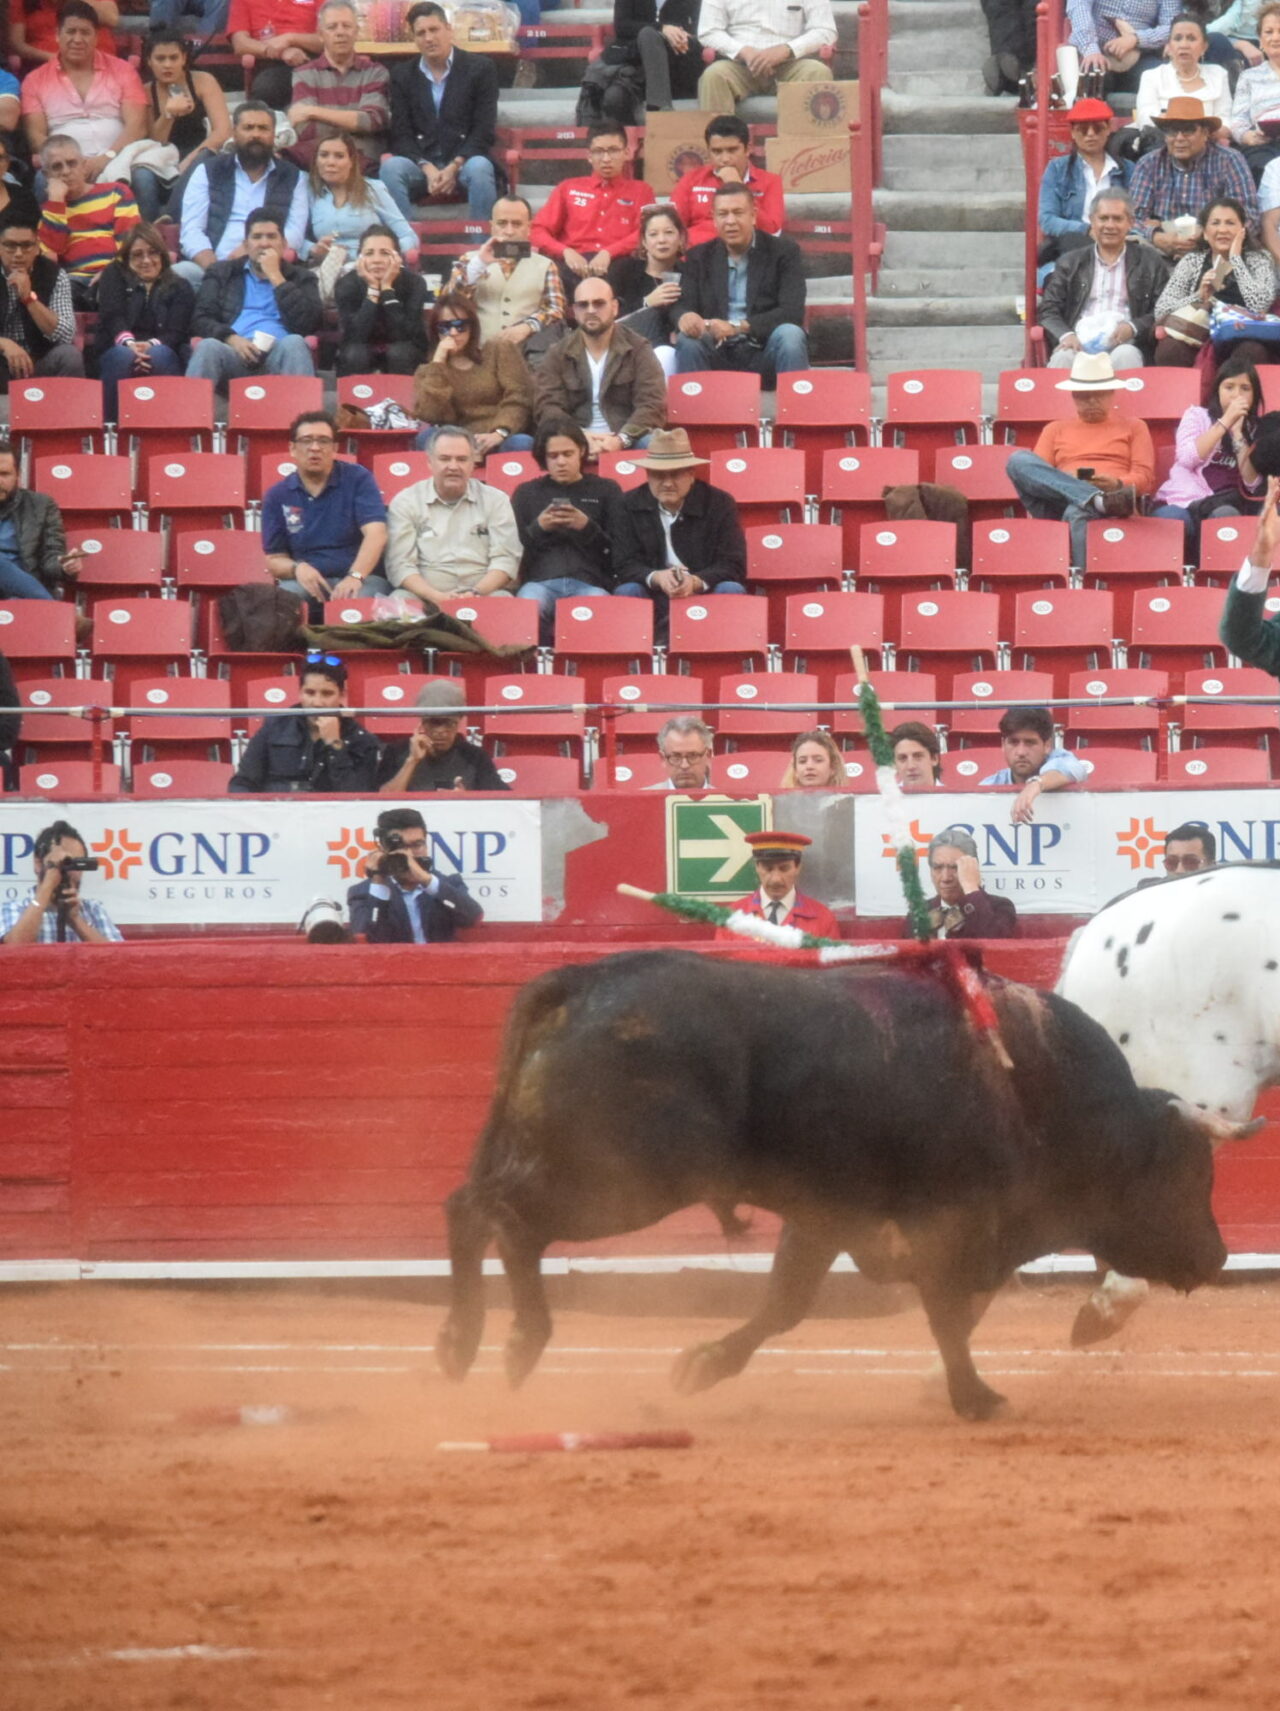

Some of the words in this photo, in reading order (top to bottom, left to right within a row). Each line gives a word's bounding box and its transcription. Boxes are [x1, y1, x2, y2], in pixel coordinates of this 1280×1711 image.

[574, 197, 587, 207] 25
[697, 194, 709, 203] 16
[149, 832, 271, 875] GNP
[427, 831, 506, 874] NP
[148, 887, 273, 900] SEGUROS
